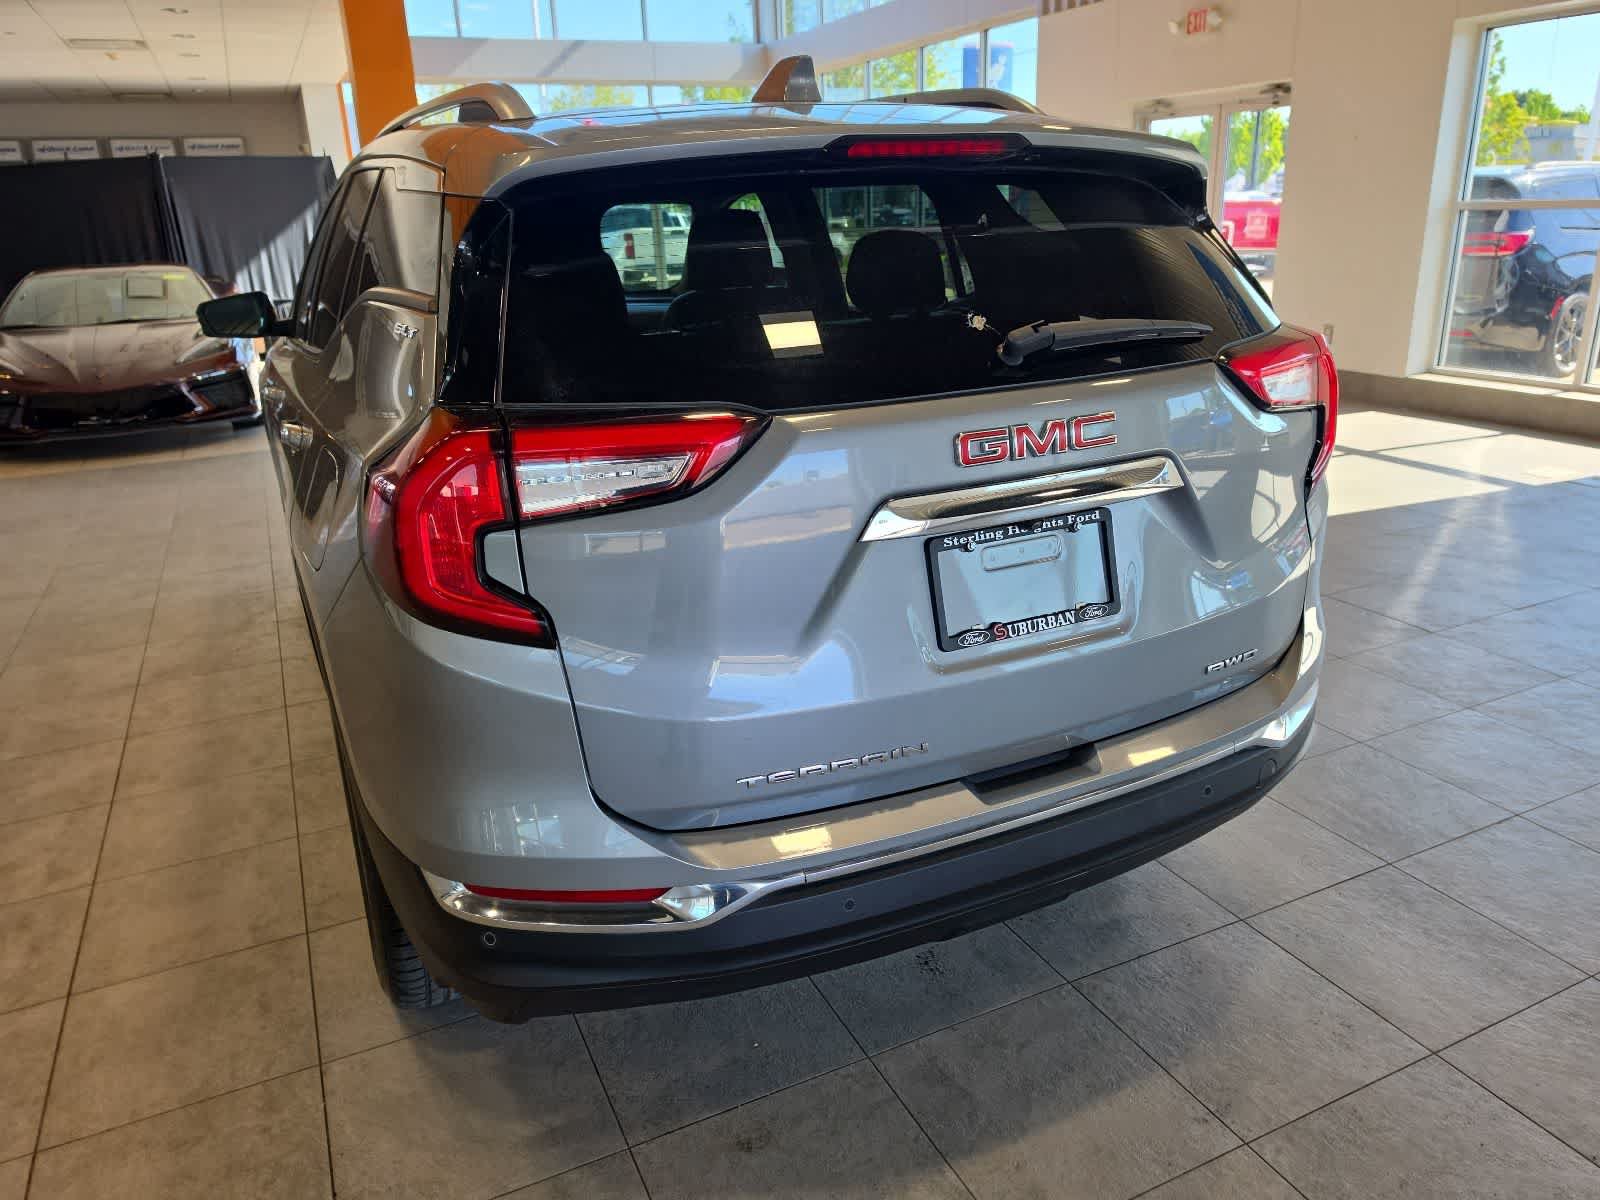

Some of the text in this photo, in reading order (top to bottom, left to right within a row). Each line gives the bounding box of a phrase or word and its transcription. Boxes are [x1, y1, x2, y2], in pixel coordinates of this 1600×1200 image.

[1187, 8, 1208, 34] EXIT
[954, 411, 1118, 467] GMC
[943, 529, 1003, 548] Sterling
[1065, 510, 1101, 525] Ford
[961, 605, 1105, 646] Ford SUBURBAN Ford
[736, 743, 929, 788] TERRAIN
